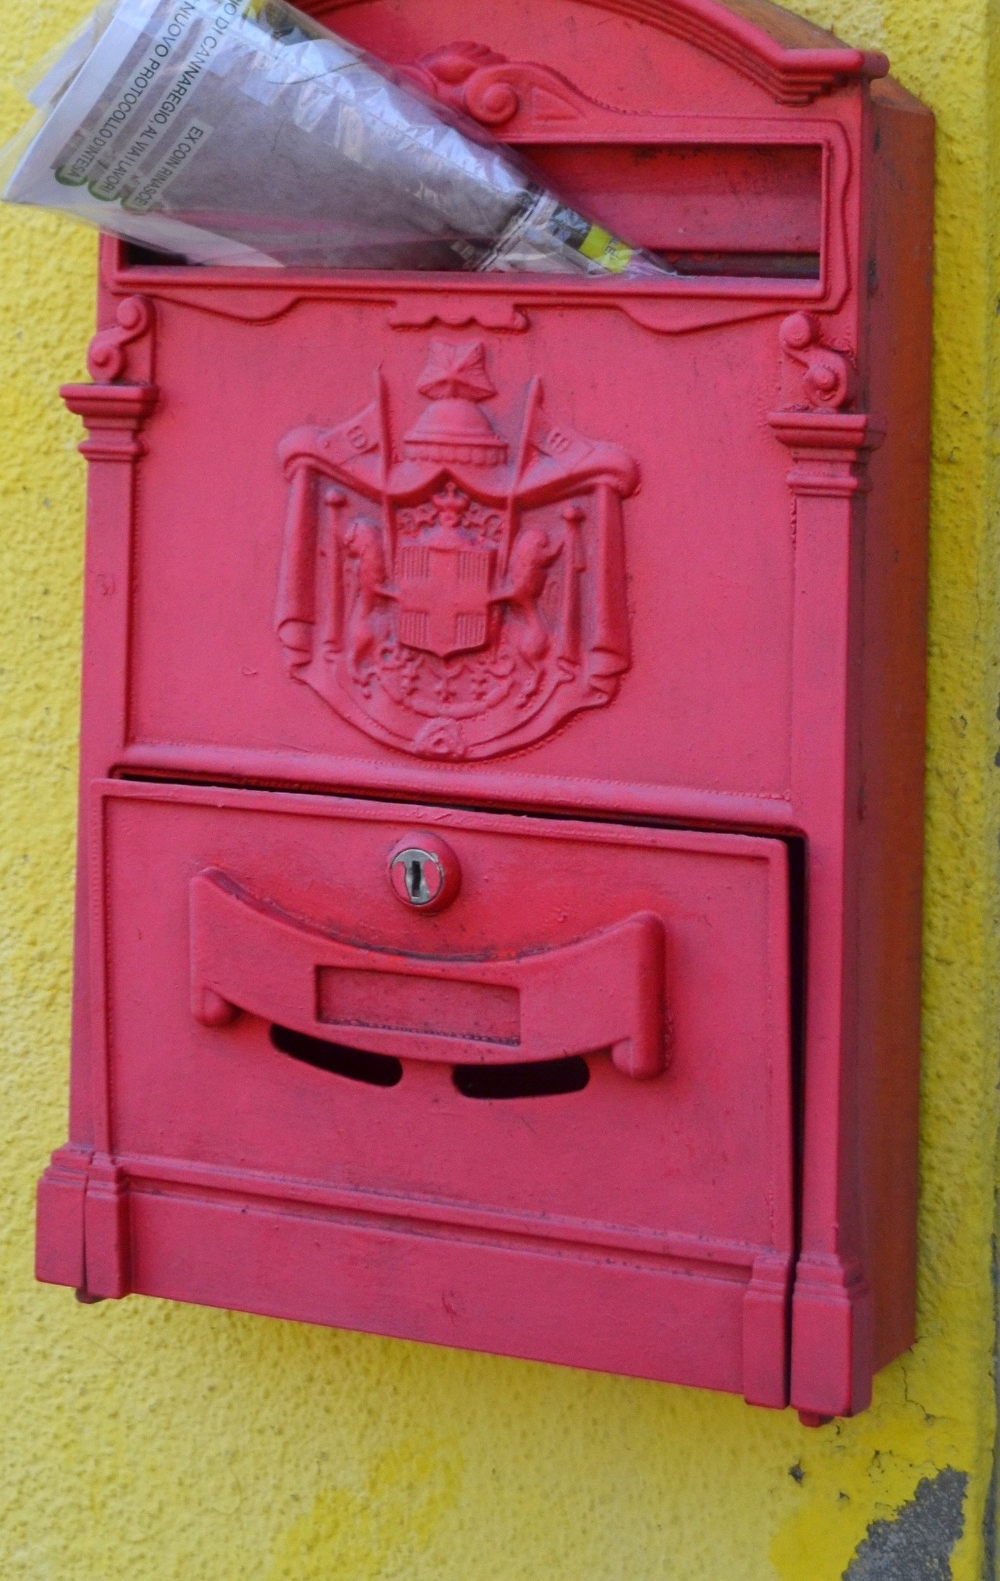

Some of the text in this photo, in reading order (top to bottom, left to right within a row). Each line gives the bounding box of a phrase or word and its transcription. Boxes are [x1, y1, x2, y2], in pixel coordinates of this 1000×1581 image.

[154, 1, 195, 58] NUOVO
[212, 16, 229, 35] DI
[150, 35, 218, 125] CANNAREGIO,
[99, 57, 161, 140] PROTOCOLLO
[140, 125, 158, 140] AL
[184, 125, 203, 145] EX
[127, 140, 149, 158] VIA
[165, 142, 192, 170] COIN
[102, 160, 131, 194] LAVORI
